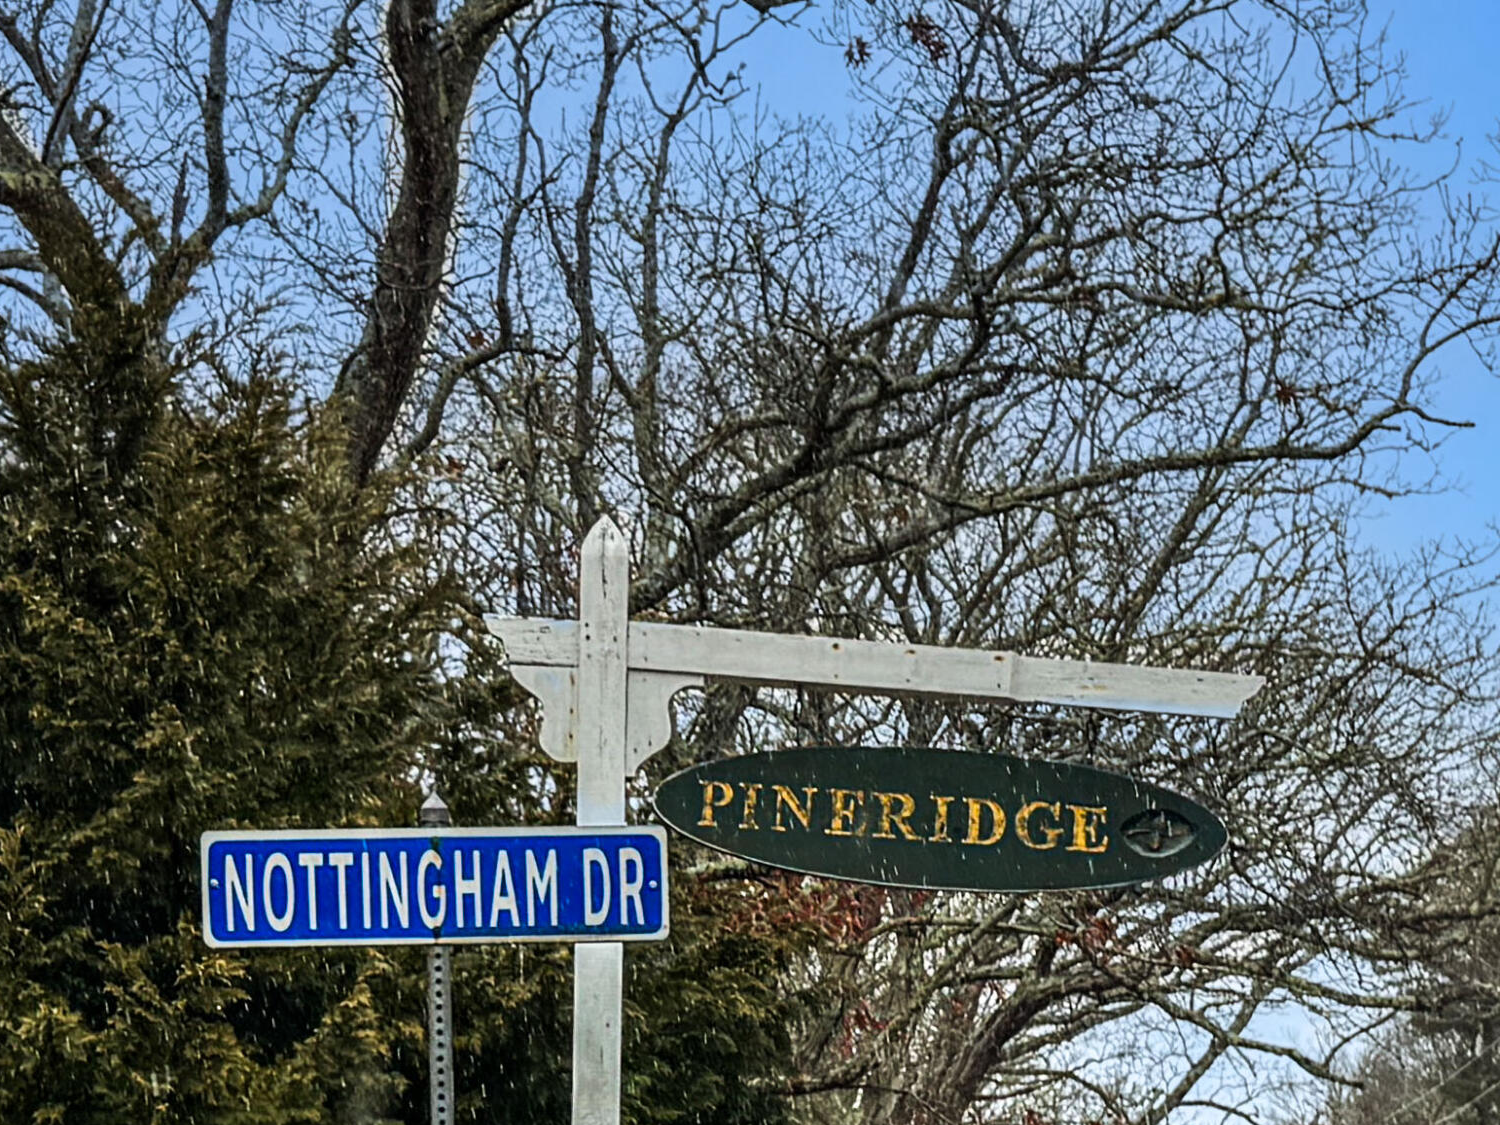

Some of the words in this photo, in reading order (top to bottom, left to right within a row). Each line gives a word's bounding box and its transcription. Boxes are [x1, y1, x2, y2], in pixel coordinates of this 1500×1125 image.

[696, 779, 1109, 853] PINERIDGE
[224, 849, 559, 932] NOTTINGHAM
[583, 846, 645, 926] DR
